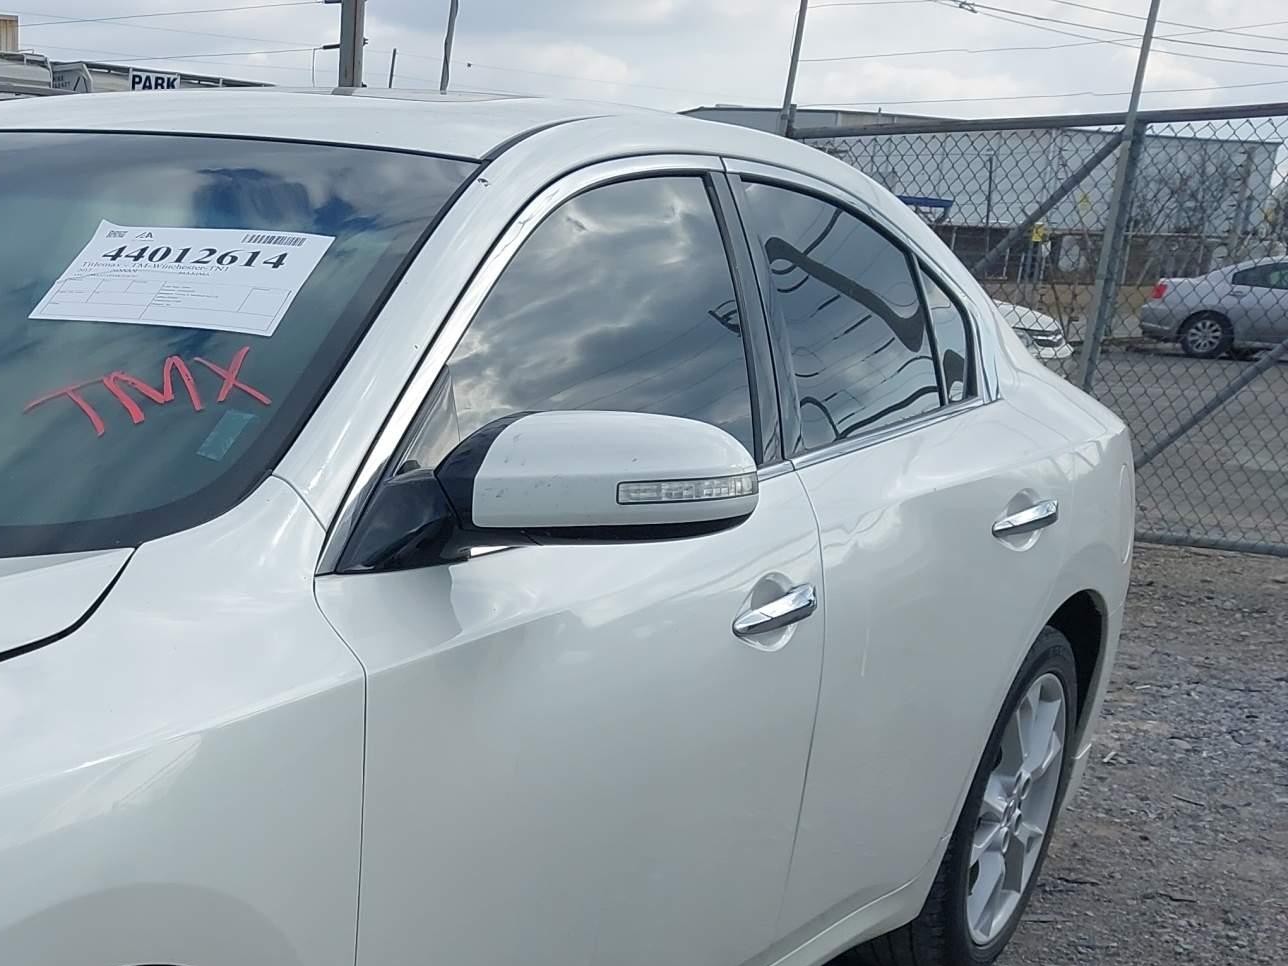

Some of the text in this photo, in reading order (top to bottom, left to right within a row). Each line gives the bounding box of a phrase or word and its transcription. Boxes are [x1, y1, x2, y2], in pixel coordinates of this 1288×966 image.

[131, 74, 178, 91] PARK
[102, 245, 289, 270] 44012614
[23, 346, 272, 437] TMX
